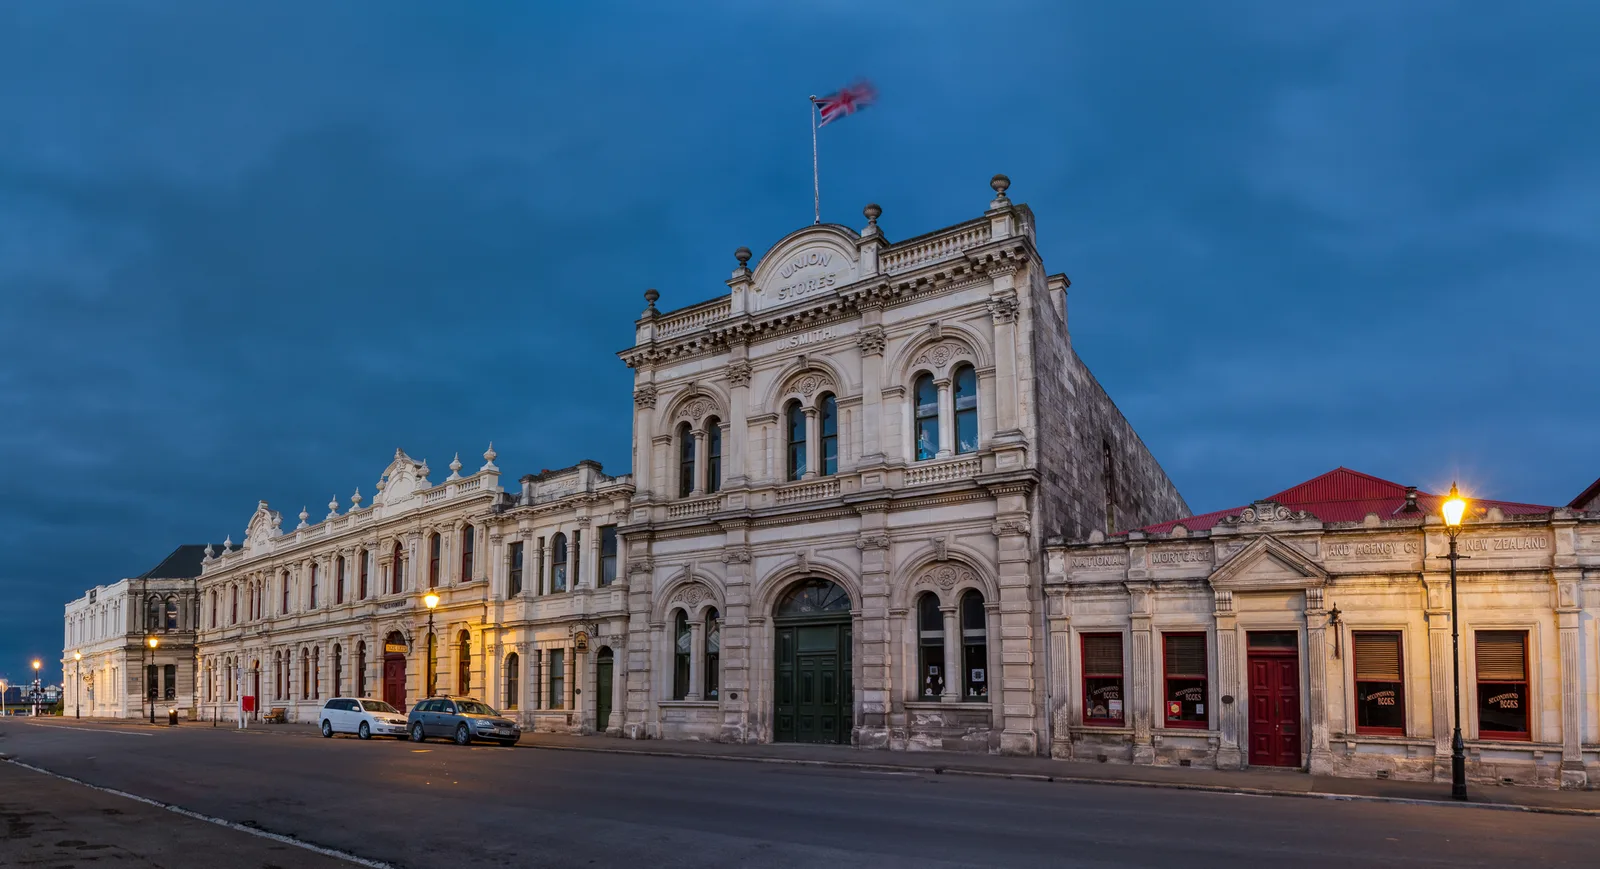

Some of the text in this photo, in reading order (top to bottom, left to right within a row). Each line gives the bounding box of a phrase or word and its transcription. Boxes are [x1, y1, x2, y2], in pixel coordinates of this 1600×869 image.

[780, 252, 832, 278] UNION
[778, 274, 836, 300] STORES
[1071, 554, 1125, 568] NATIONAL
[1151, 550, 1210, 564] MORTGAGE
[1328, 544, 1351, 557] AND
[1356, 542, 1399, 556] AGENCY
[1465, 538, 1489, 552] NEW
[1493, 536, 1548, 550] ZEALAND
[1499, 699, 1519, 709] BOOKS
